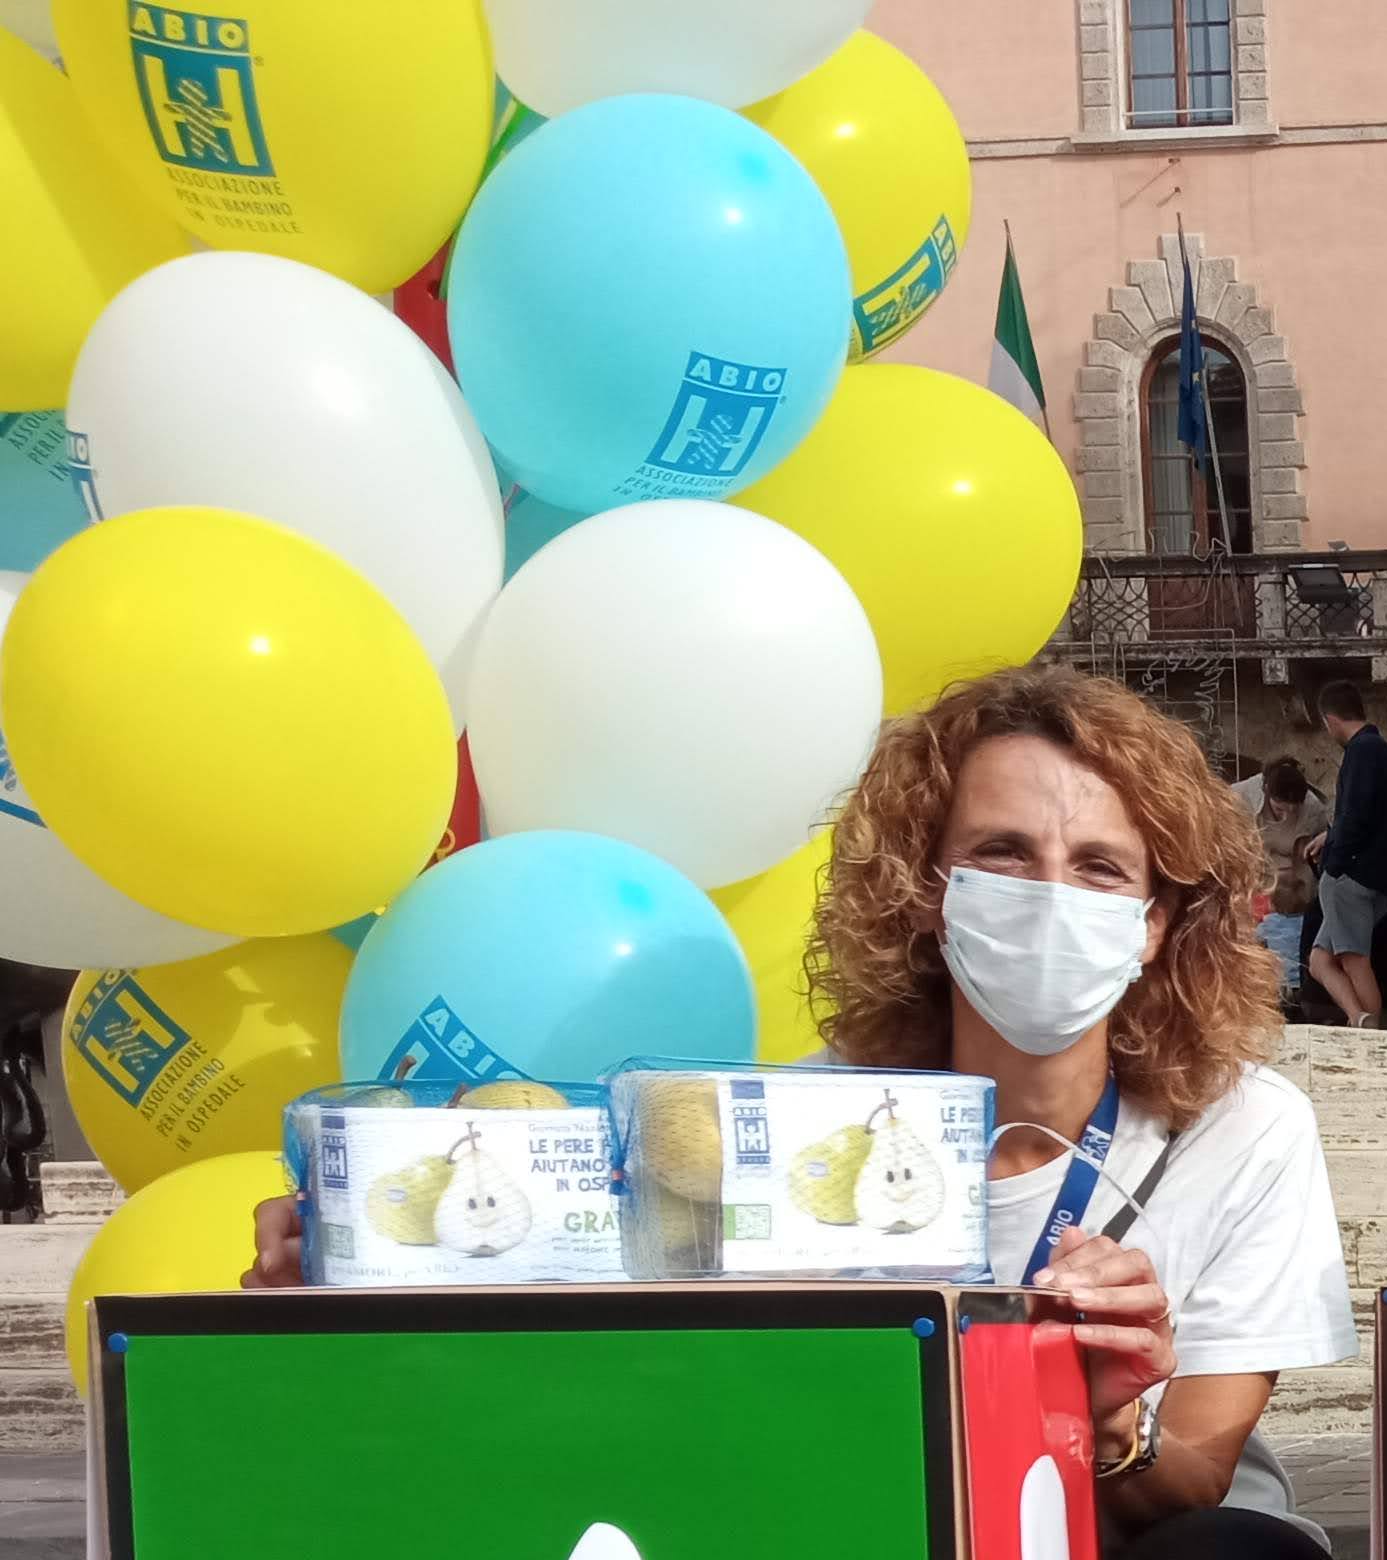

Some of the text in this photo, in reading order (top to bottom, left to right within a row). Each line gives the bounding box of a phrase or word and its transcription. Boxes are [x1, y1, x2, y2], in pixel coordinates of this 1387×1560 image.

[132, 6, 245, 49] ABIO
[688, 357, 782, 393] ABIO
[624, 476, 650, 491] PER
[635, 465, 734, 487] ASSOCIAZIONE
[424, 1007, 523, 1079] ABI
[139, 1041, 209, 1122] ASSOCIAZIONE
[155, 1113, 181, 1139] PER
[176, 1056, 226, 1105] BAMBINO
[174, 1073, 247, 1153] IN OSPEDALE
[940, 1106, 956, 1123] LE
[529, 1138, 594, 1154] LE PERE
[531, 1158, 606, 1173] AIUTANO
[556, 1178, 570, 1192] IN
